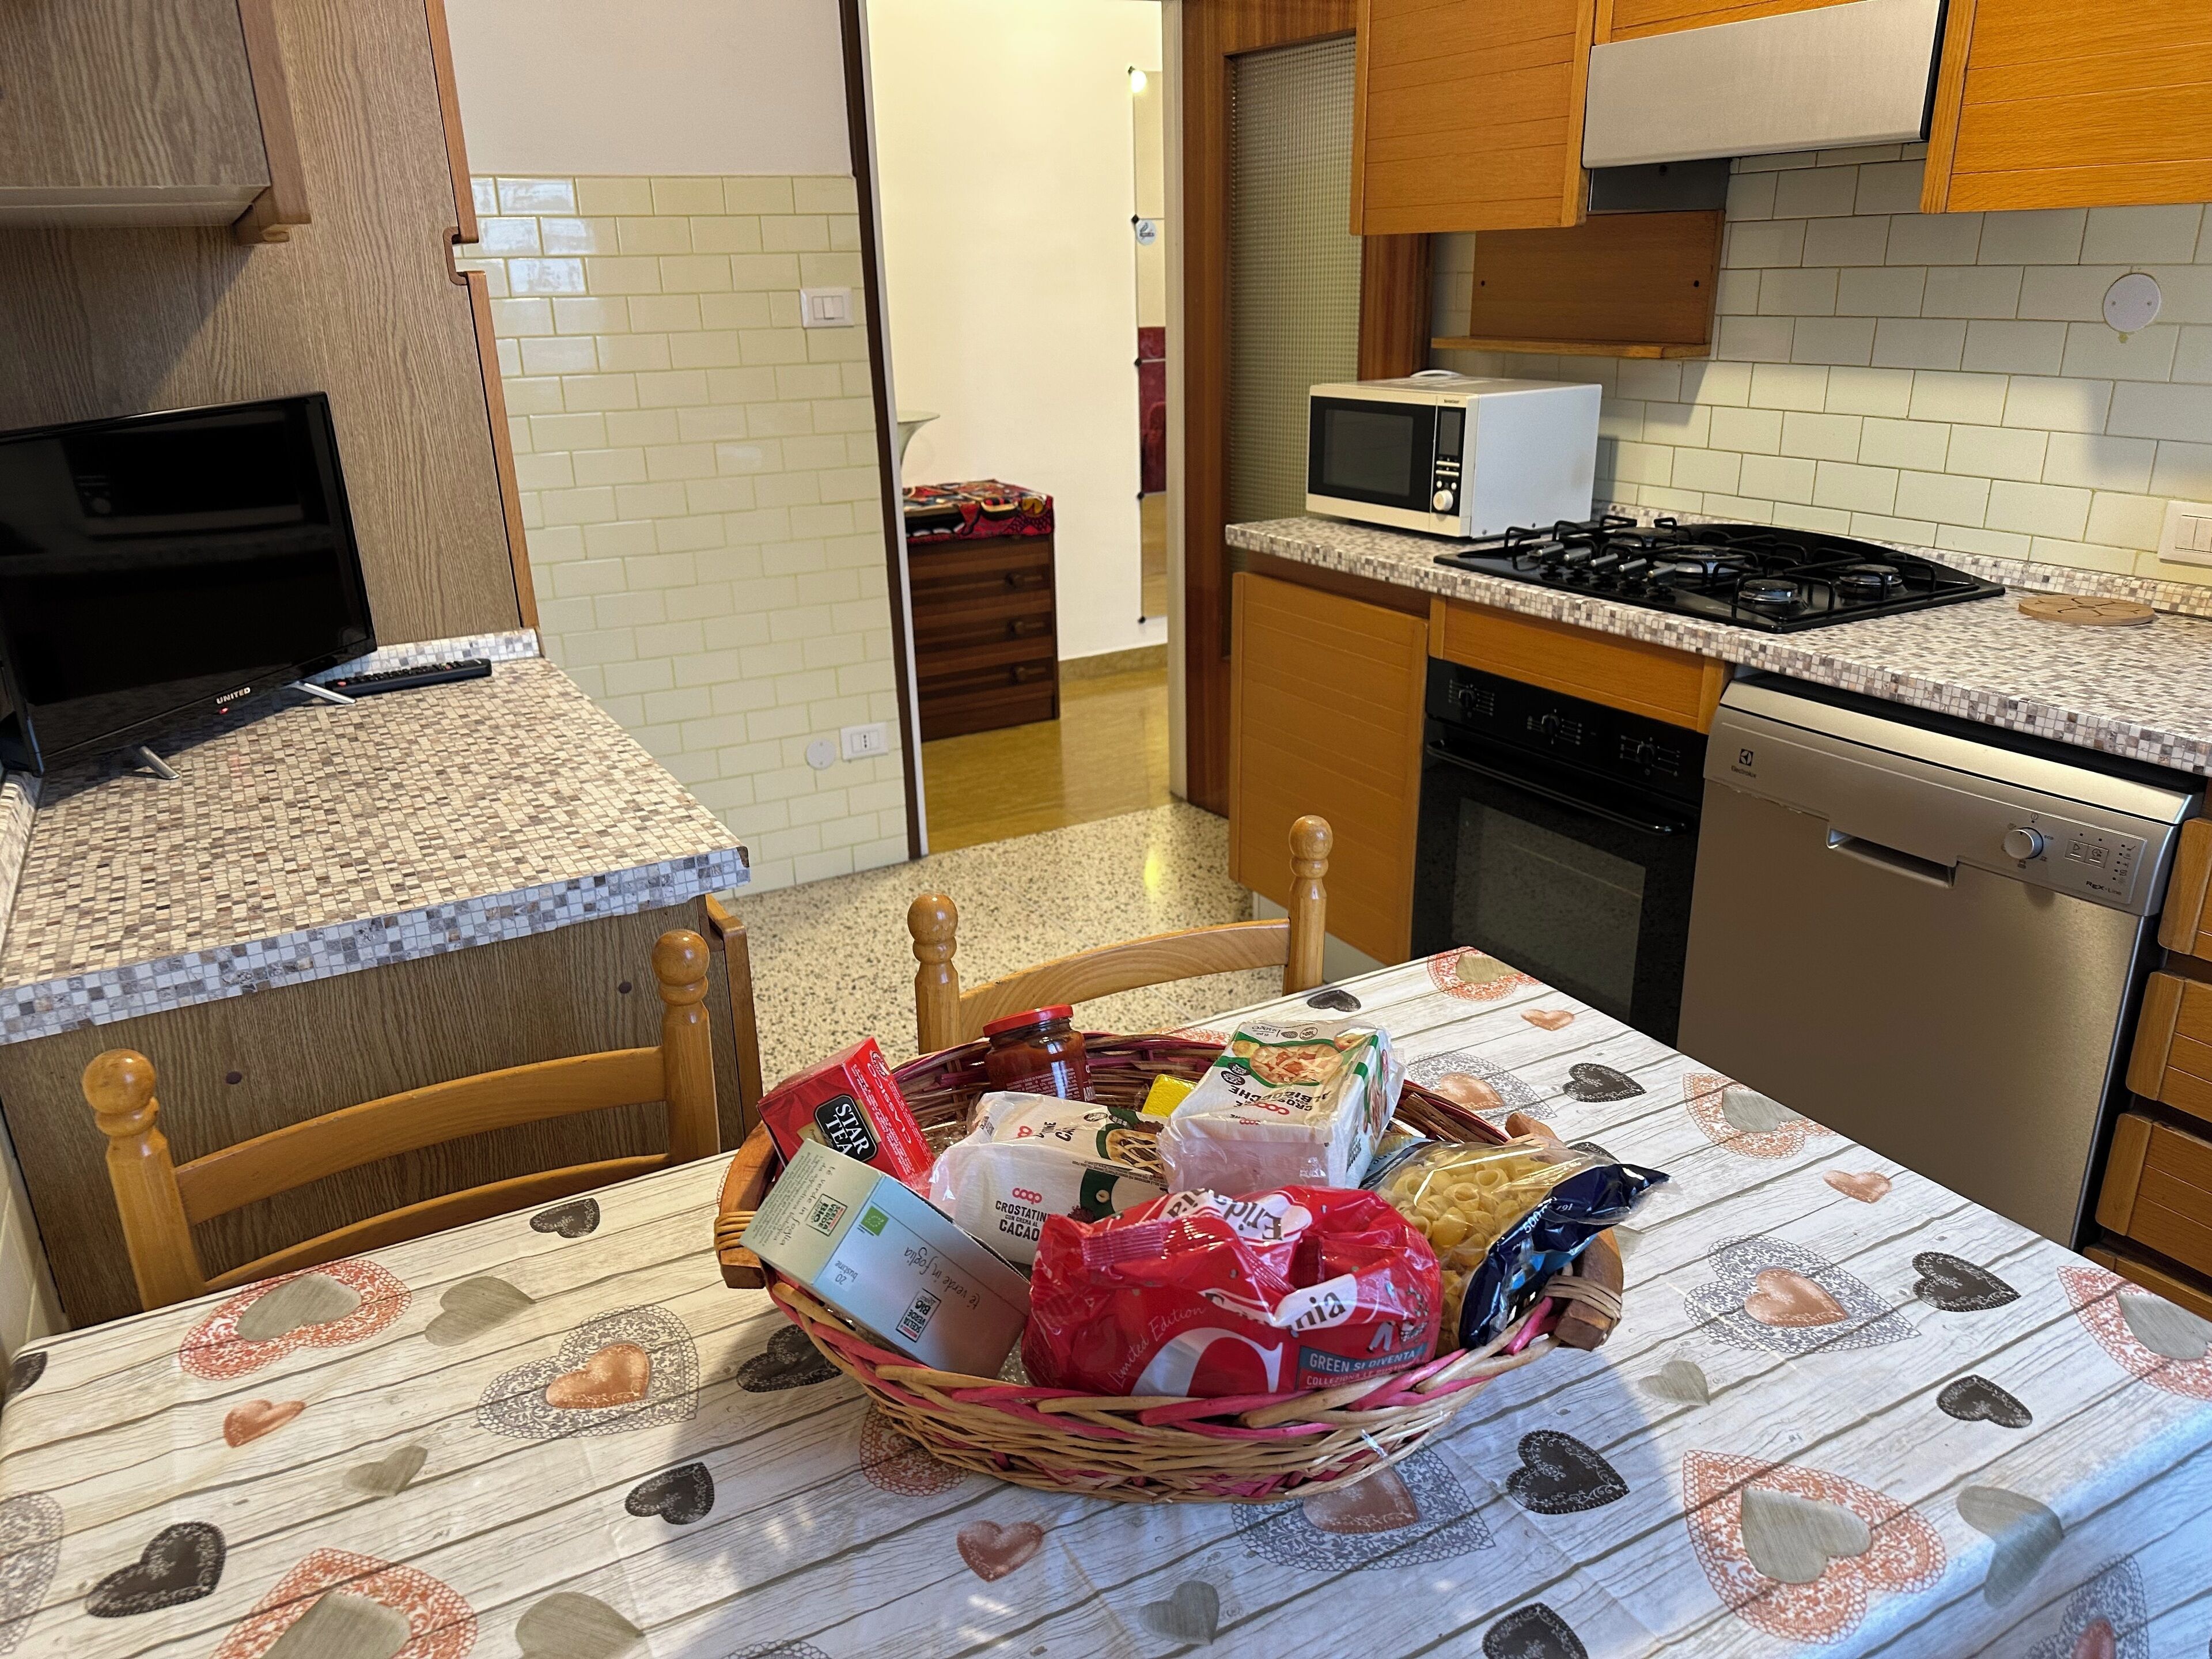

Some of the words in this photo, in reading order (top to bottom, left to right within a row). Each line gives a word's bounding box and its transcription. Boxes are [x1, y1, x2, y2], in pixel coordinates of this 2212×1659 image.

[216, 687, 251, 704] UNITED
[867, 1062, 912, 1144] CLASSICO
[825, 1114, 854, 1154] TEA
[835, 1103, 870, 1154] STAR
[806, 1179, 826, 1203] verde
[1012, 1188, 1042, 1205] coop
[800, 1207, 808, 1215] in
[817, 1203, 836, 1228] VERDE
[822, 1204, 842, 1229] SCELTA
[995, 1200, 1050, 1222] CROSTATIN
[1016, 1217, 1031, 1225] CREMA
[780, 1214, 801, 1245] foglia
[999, 1219, 1040, 1241] CACAO
[835, 1260, 859, 1283] bustine
[904, 1247, 939, 1275] foglia
[835, 1271, 847, 1285] 20
[931, 1262, 942, 1283] in
[942, 1275, 968, 1297] verde
[903, 1316, 922, 1334] SCELTA
[907, 1308, 926, 1325] VERDE
[1107, 1334, 1149, 1388] Limited
[1148, 1306, 1207, 1342] Edition
[1309, 1353, 1350, 1372] GREEN
[1354, 1362, 1365, 1371] SI
[1368, 1350, 1415, 1368] DIVENTA
[1306, 1374, 1359, 1386] COLLEZIONA
